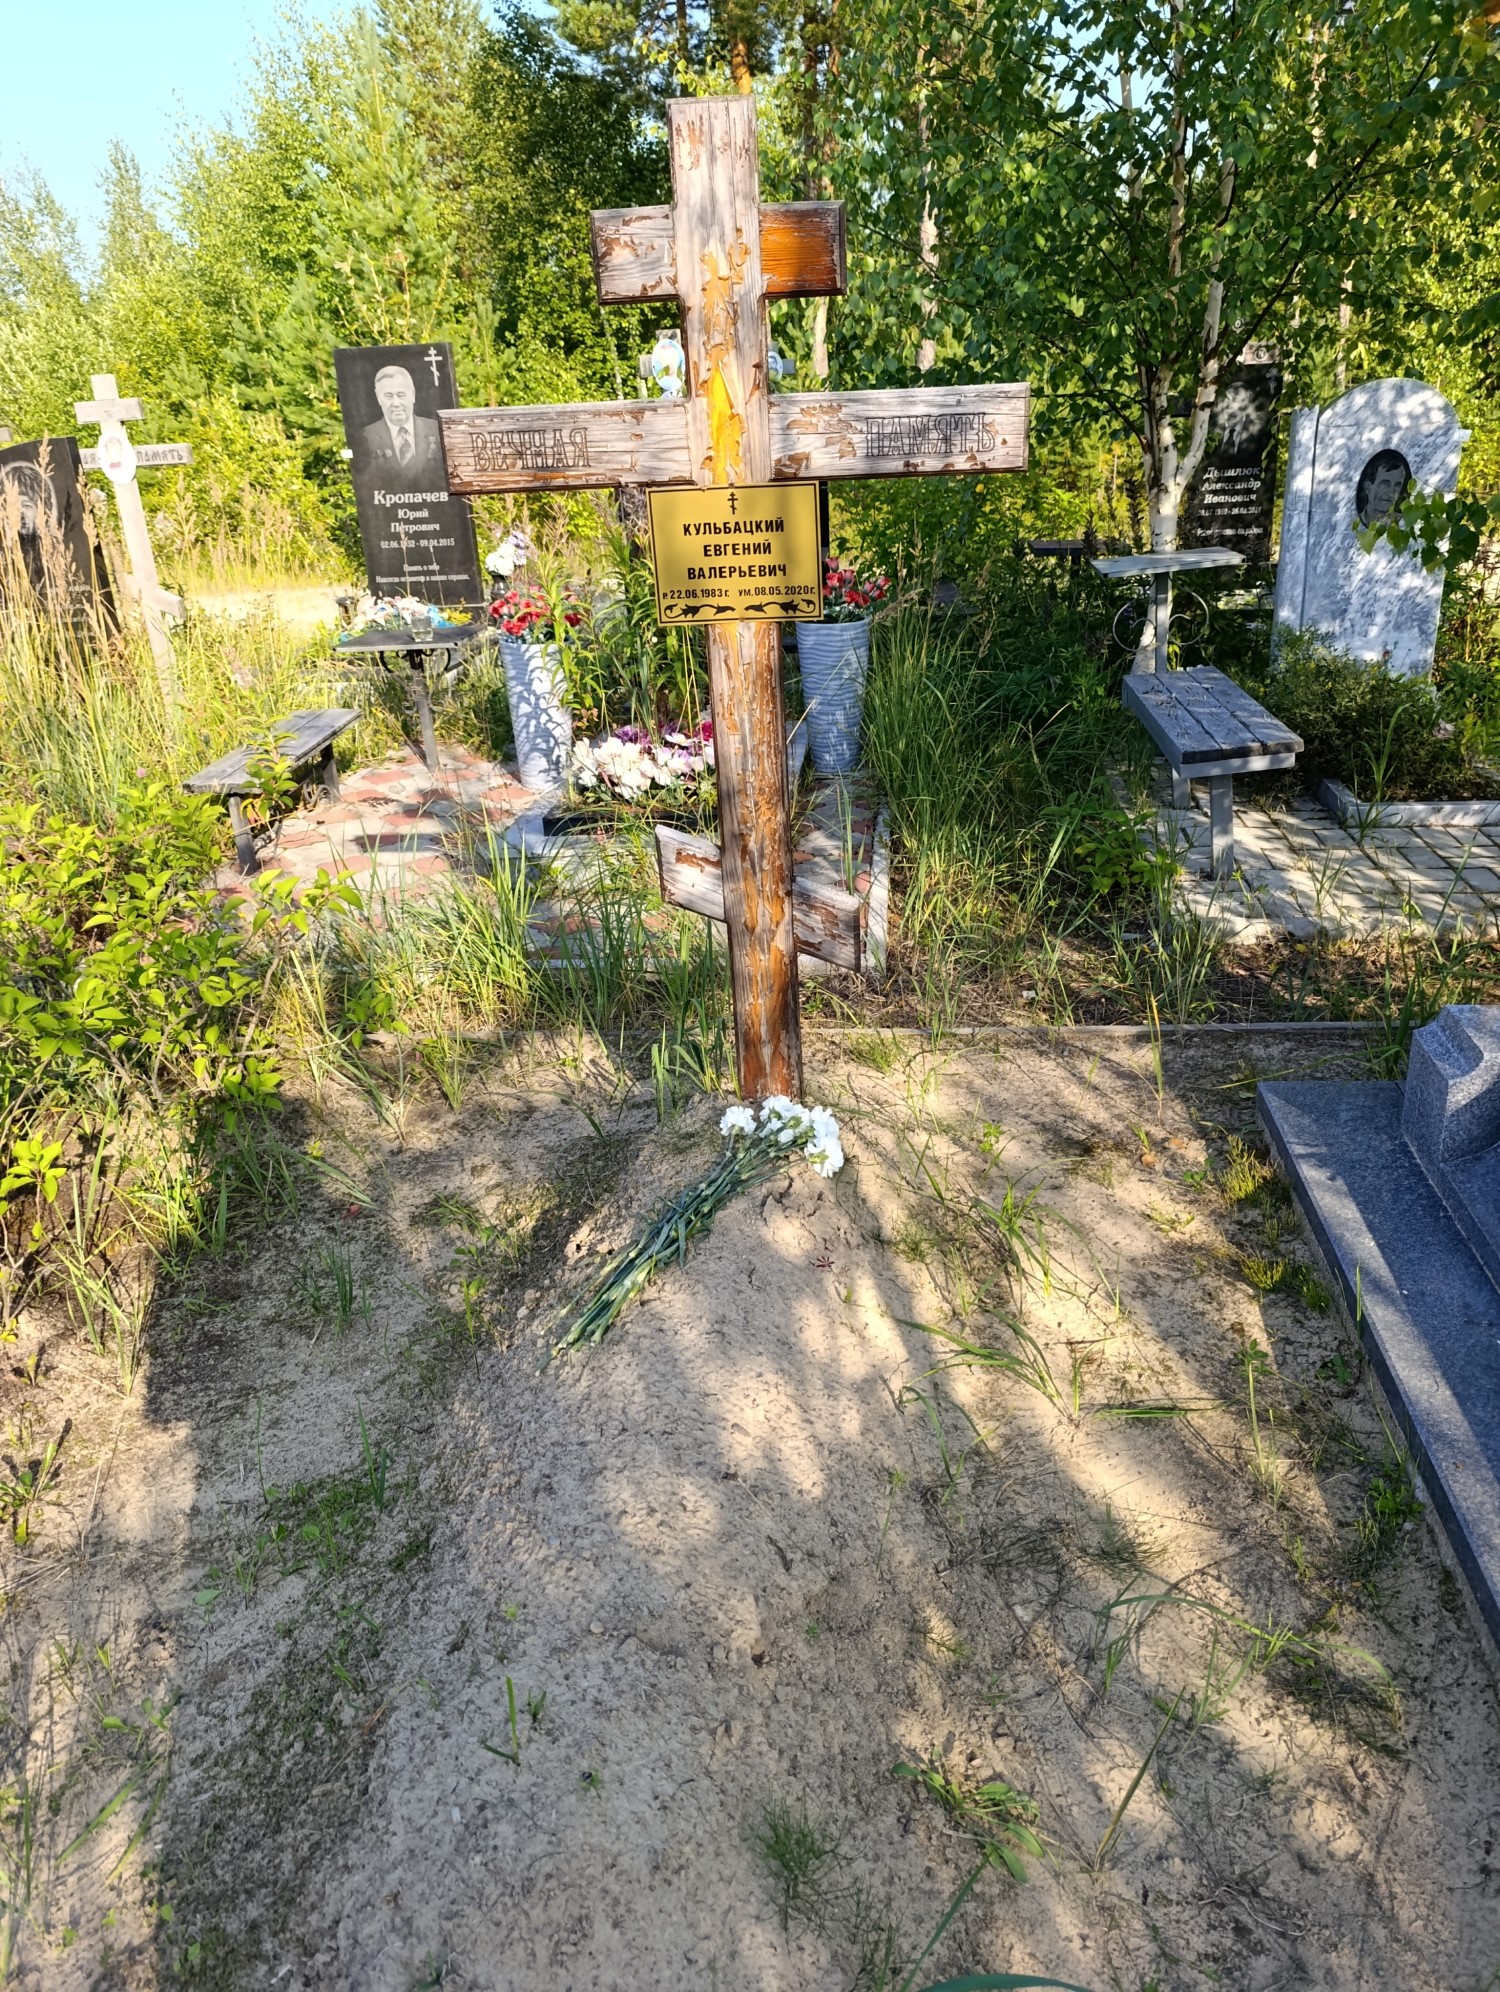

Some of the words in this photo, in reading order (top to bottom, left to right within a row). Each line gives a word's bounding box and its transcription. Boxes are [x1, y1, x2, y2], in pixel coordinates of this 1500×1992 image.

[469, 428, 591, 471] ВЕЧНАЯ
[865, 412, 996, 456] ПАМЯТЬ
[136, 449, 184, 463] ПАМЯТЬ
[1201, 478, 1261, 491] Александр
[373, 490, 449, 507] Кропачев
[1203, 493, 1257, 504] Иванович
[397, 508, 429, 520] Юрий
[683, 517, 785, 536] КУЛЬБАЦКИЙ
[703, 539, 772, 557] ЕВГЕНИЙ
[687, 564, 787, 580] ВАЛЕРЬЕВИЧ
